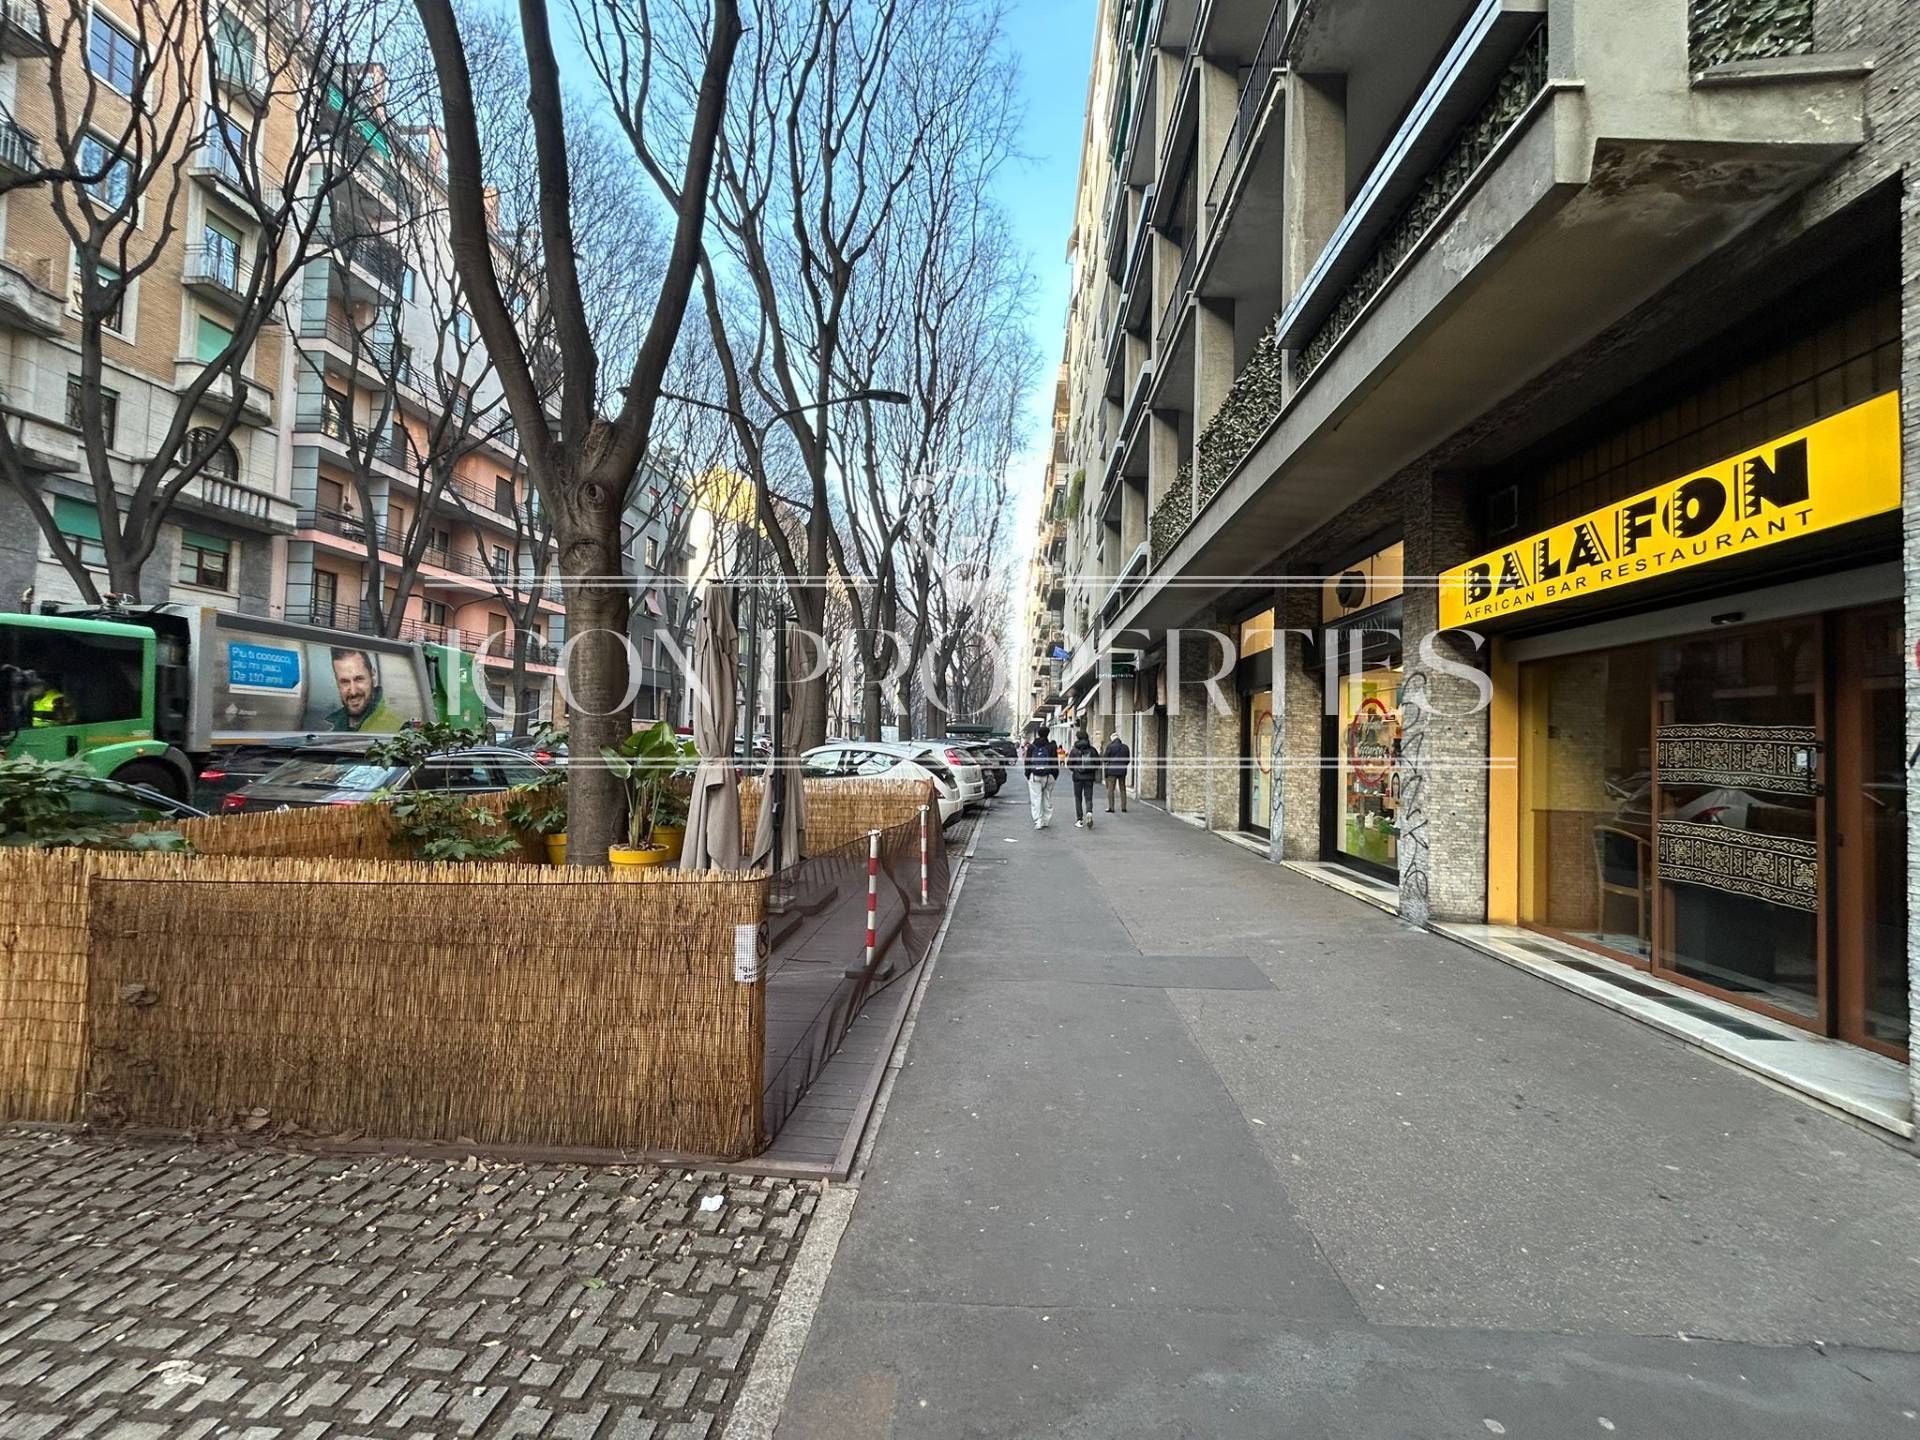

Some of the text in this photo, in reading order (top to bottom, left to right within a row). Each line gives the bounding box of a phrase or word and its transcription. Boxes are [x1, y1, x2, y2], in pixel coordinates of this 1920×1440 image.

[1464, 437, 1810, 606] BALAFON
[1465, 508, 1815, 621] AFRICAN BAR RESTAURANT
